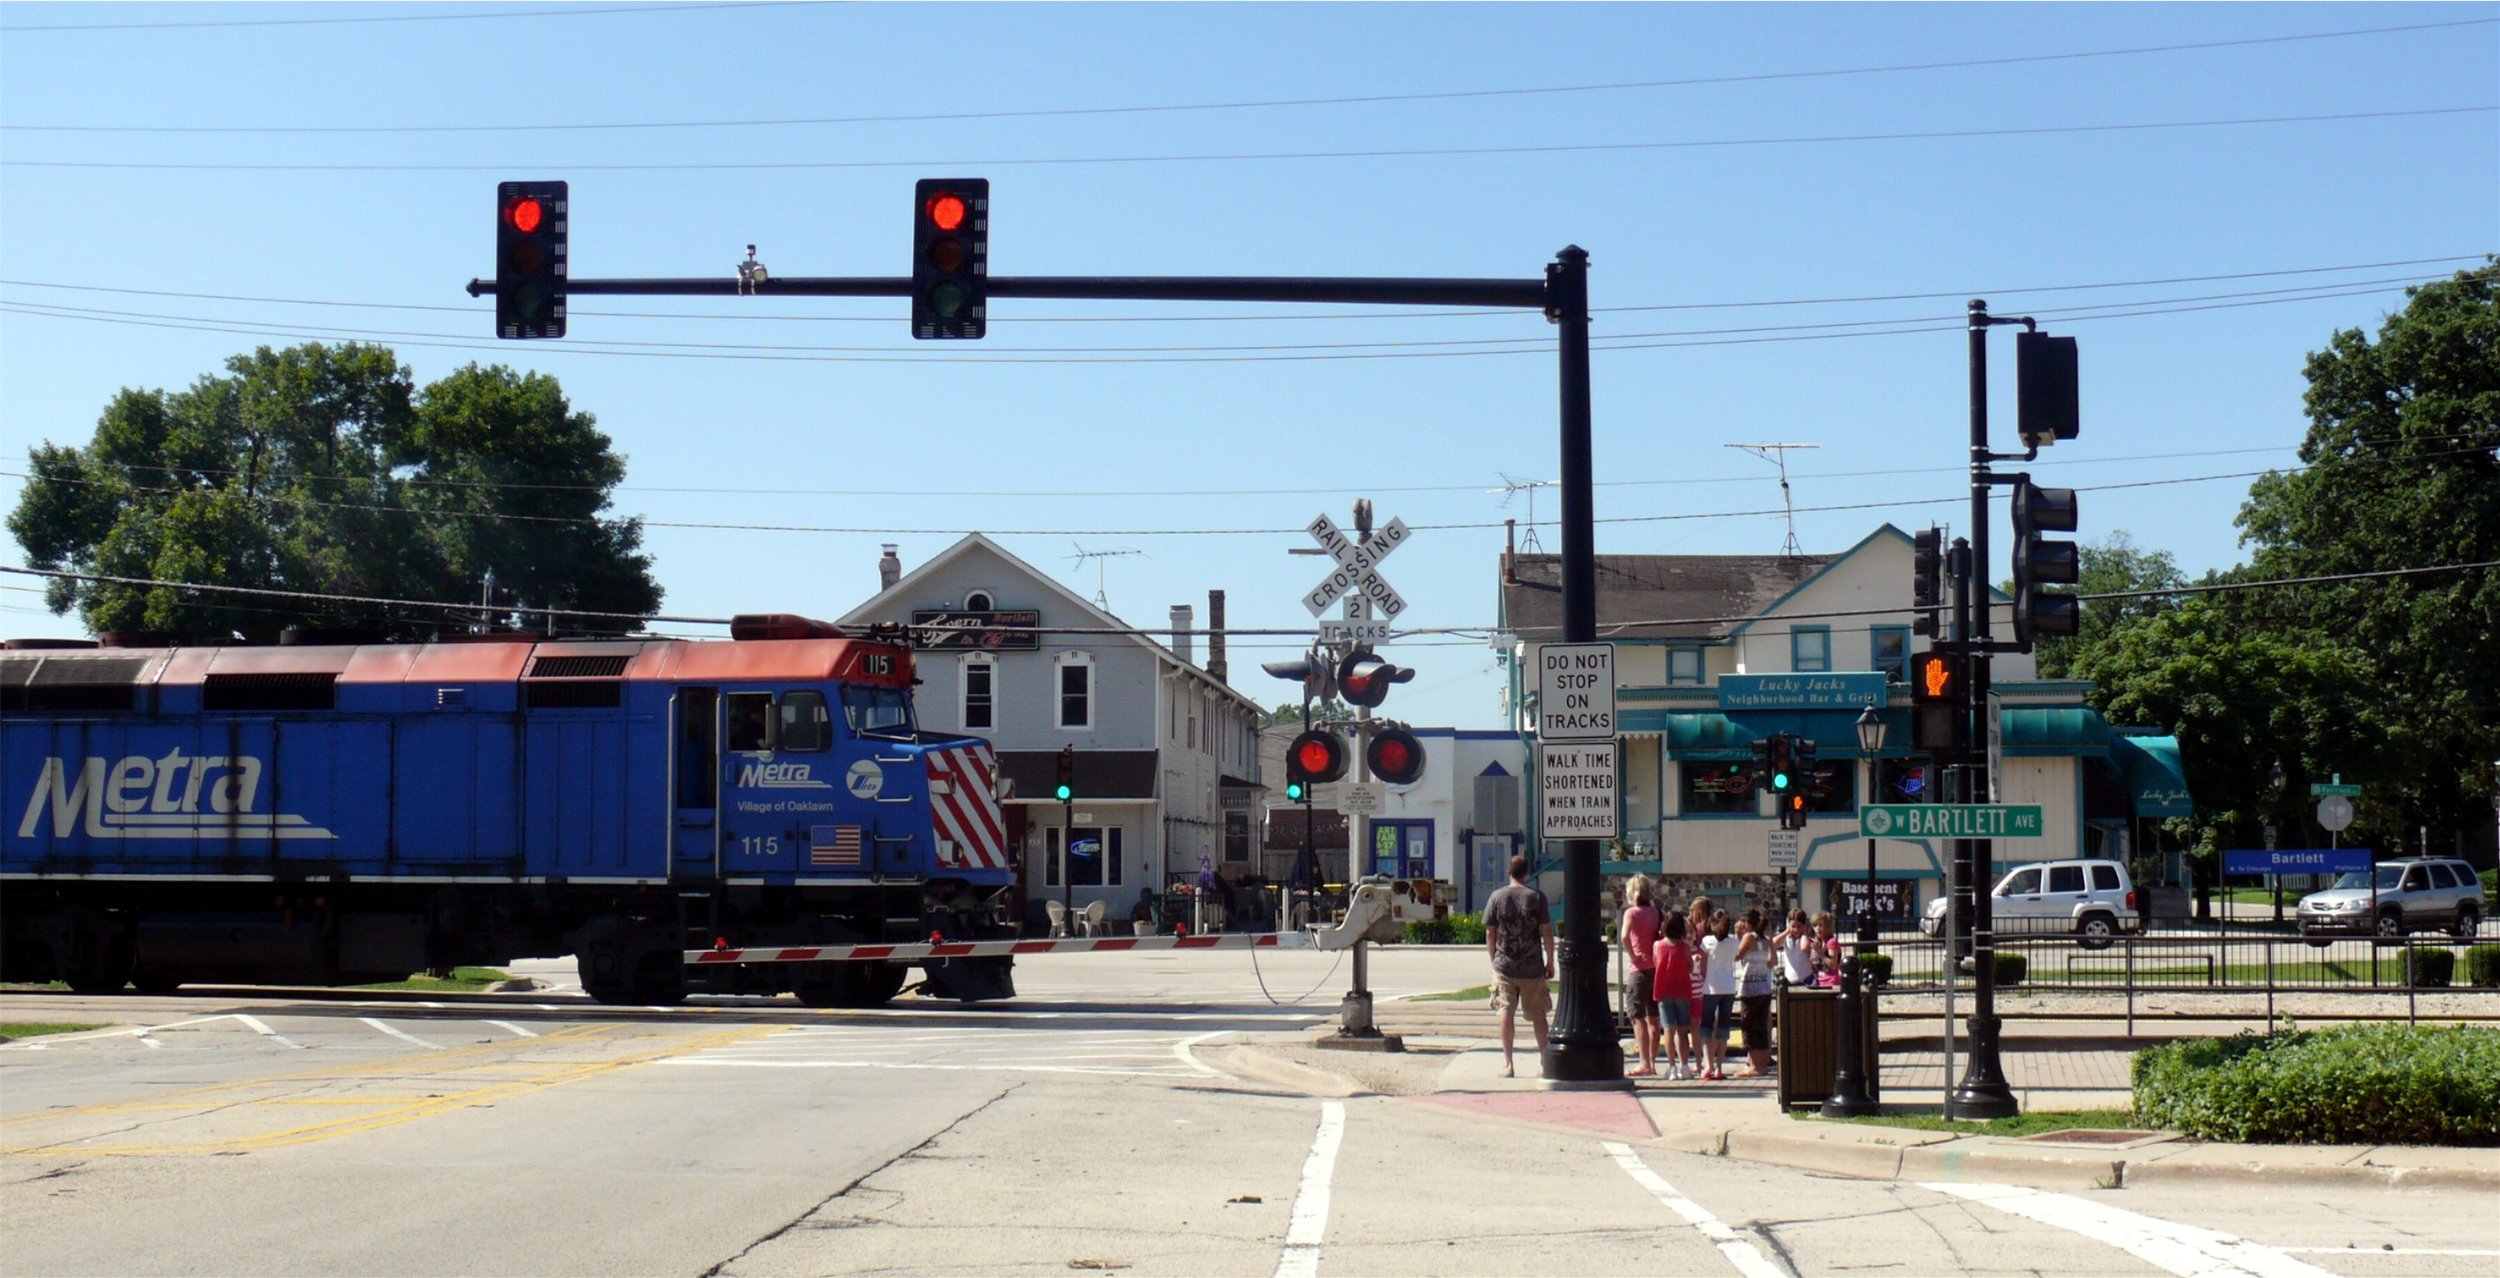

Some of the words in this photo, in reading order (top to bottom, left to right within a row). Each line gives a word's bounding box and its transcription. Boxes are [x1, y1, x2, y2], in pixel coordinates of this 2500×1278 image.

[1312, 519, 1347, 560] RAIL
[1361, 573, 1400, 615] ROAD
[1312, 526, 1401, 608] CROSSING
[1350, 602, 1360, 618] 2
[869, 654, 888, 675] 115
[1547, 655, 1569, 670] DO
[1576, 654, 1608, 669] NOT
[1557, 674, 1598, 689] STOP
[1758, 679, 1800, 692] Lucky
[1806, 678, 1847, 691] Jacks
[1566, 694, 1588, 709] ON
[1727, 694, 1804, 706] Neighborhood
[1810, 693, 1829, 704] Bar
[1834, 693, 1844, 703] &
[1545, 713, 1610, 729] TRACKS
[1546, 753, 1578, 768] WALK
[1585, 753, 1611, 768] TIME
[738, 762, 811, 788] Metra
[1545, 775, 1613, 789] SHORTENED
[18, 747, 262, 838] Metra
[737, 801, 772, 813] Village
[774, 801, 785, 811] of
[787, 801, 833, 811] Oaklawn
[1549, 796, 1576, 808] WHEN
[1581, 796, 1610, 808] TRAIN
[1546, 815, 1613, 828] APPROACHES
[1895, 815, 1904, 828] W
[1909, 809, 2007, 834] BARTLETT
[2015, 815, 2035, 828] AVE
[742, 836, 778, 855] 115
[2271, 853, 2325, 864] Bartlett
